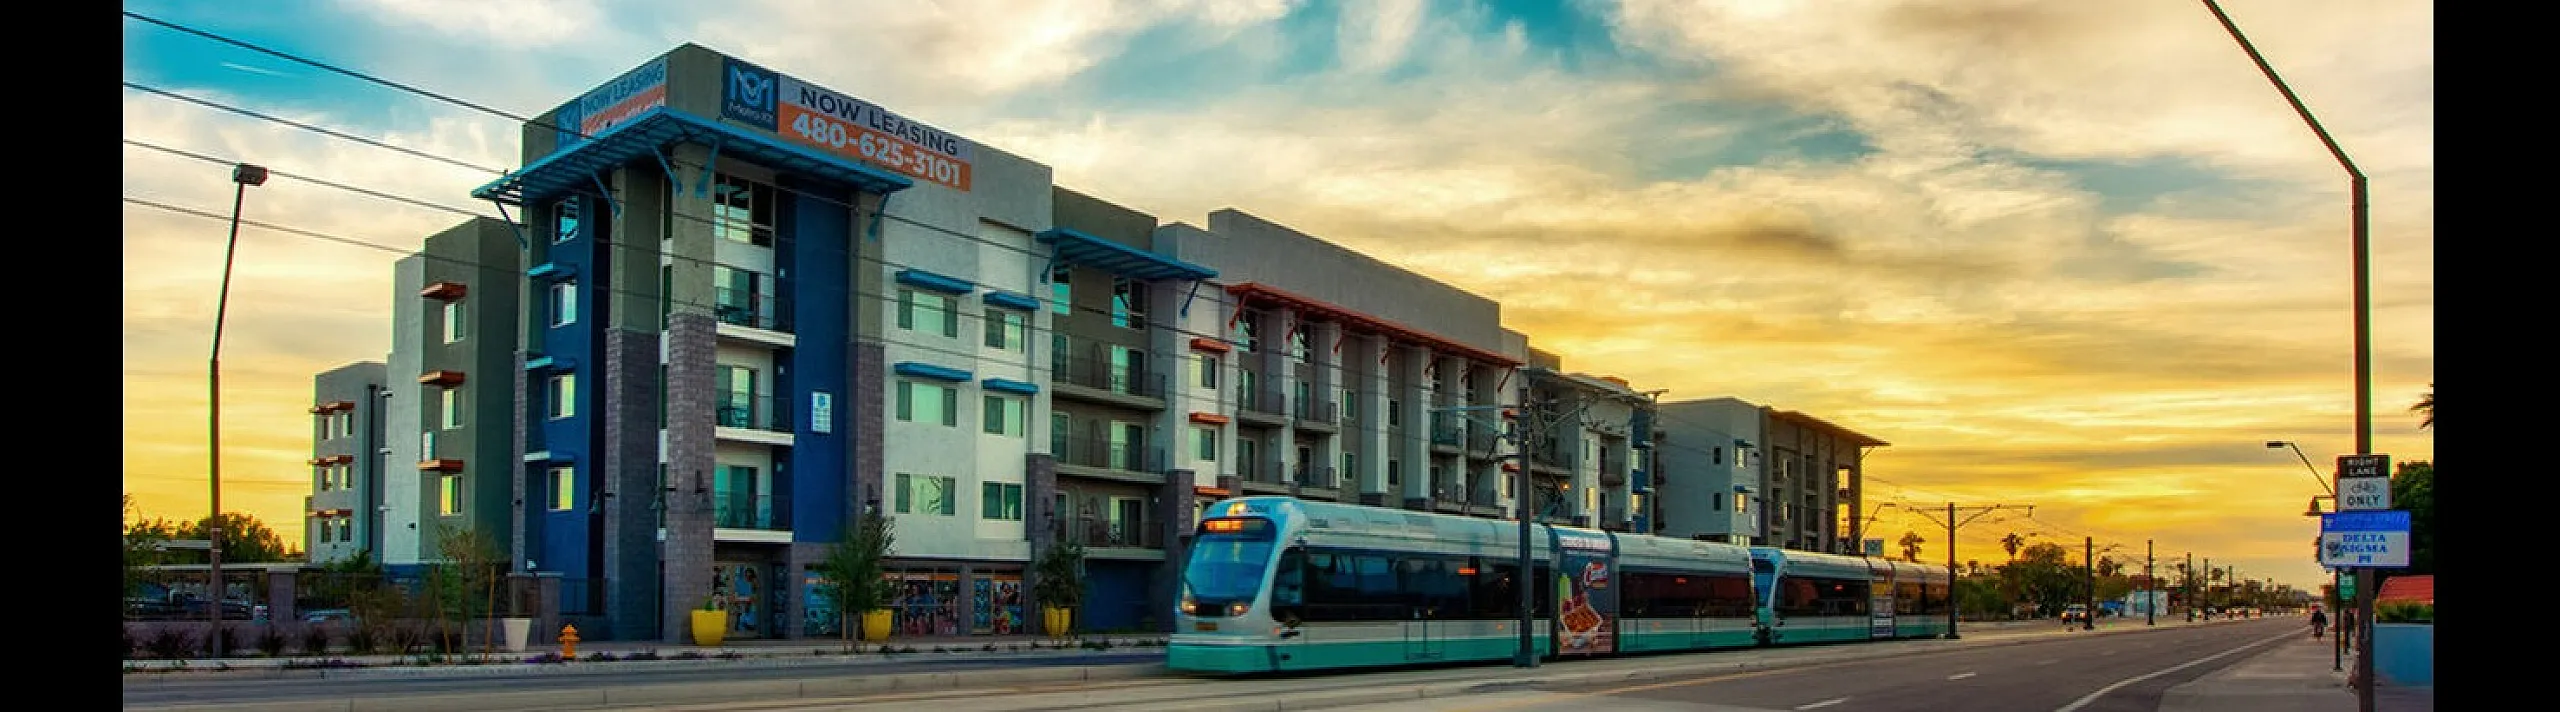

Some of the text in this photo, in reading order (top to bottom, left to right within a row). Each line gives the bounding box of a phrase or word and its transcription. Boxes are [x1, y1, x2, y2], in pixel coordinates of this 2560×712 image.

[614, 63, 663, 99] LEASING
[800, 86, 958, 156] NOW LEASING
[791, 112, 961, 185] 480-625-3101
[2346, 457, 2380, 466] RIGHT
[2348, 467, 2377, 475] LANE
[2346, 494, 2381, 506] ONLY
[2342, 534, 2387, 543] DELTA
[2342, 544, 2388, 553] SIGMA
